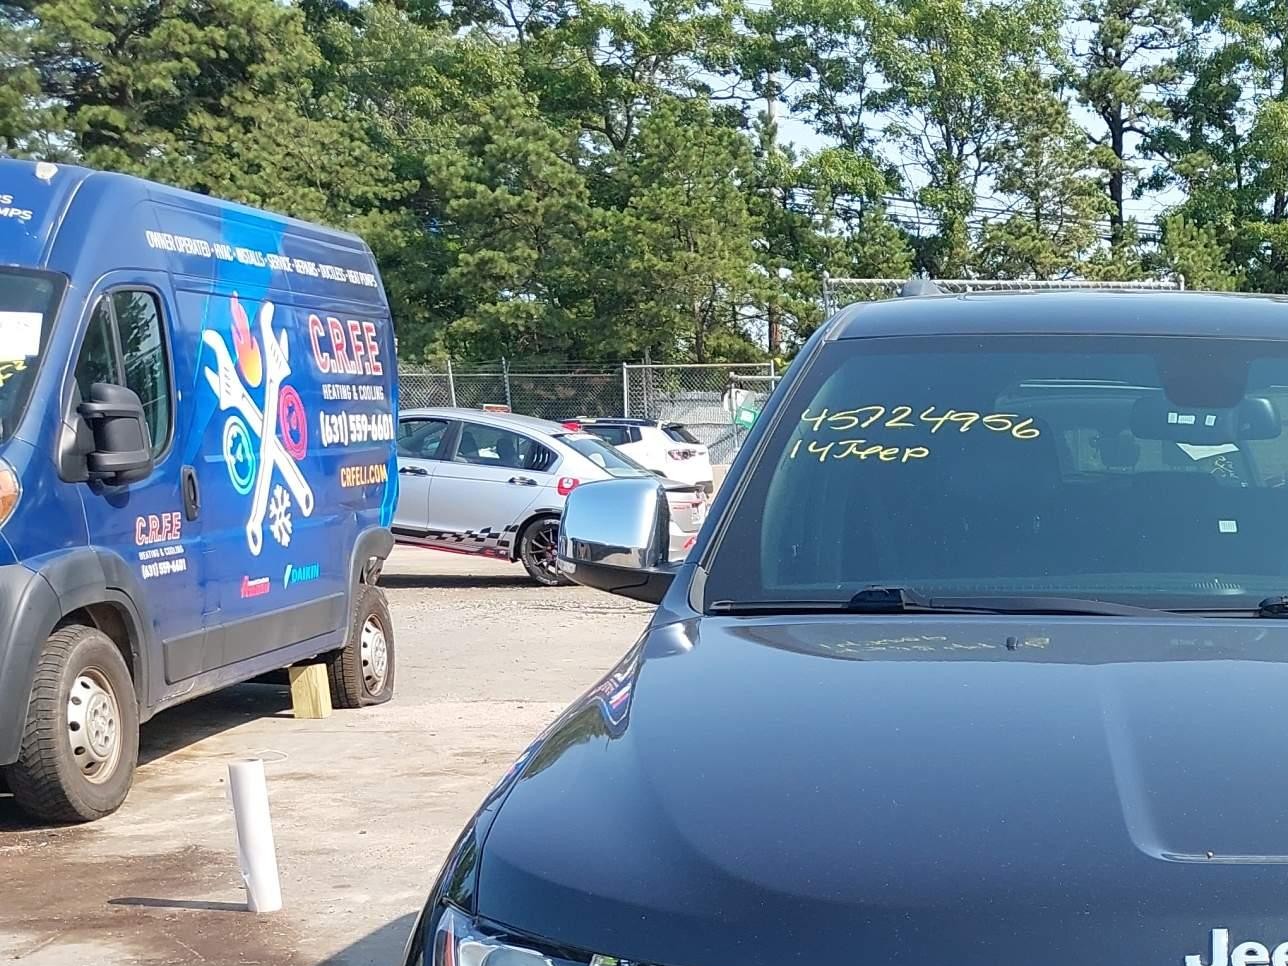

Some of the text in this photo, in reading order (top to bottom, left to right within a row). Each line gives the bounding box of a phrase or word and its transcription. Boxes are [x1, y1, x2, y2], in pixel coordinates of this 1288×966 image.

[321, 383, 385, 400] HEATING & COOLING
[319, 410, 395, 448] (631) 559-6601
[800, 406, 1042, 440] 45724956
